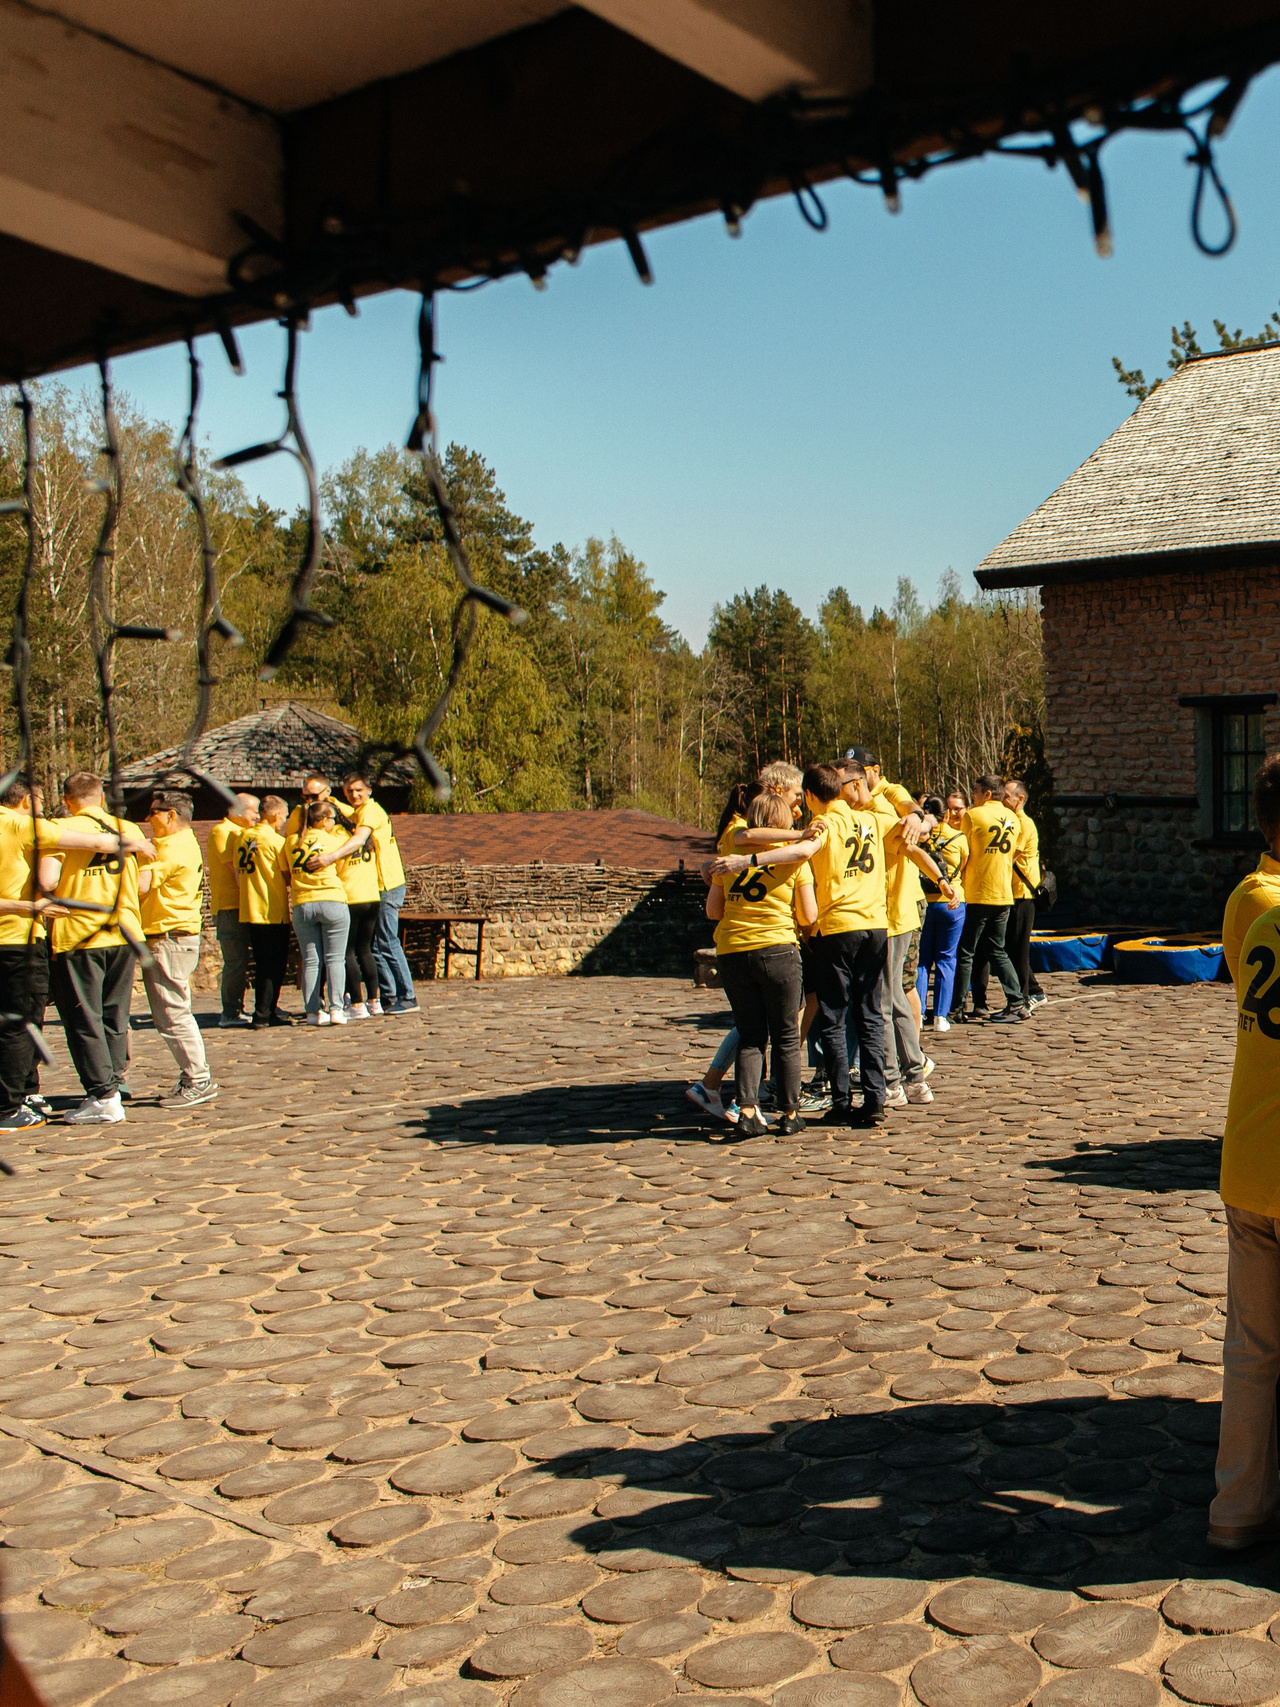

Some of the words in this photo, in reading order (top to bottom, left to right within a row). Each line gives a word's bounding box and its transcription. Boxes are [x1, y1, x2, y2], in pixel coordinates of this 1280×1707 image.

[988, 825, 1011, 854] 26
[238, 847, 255, 874] 26
[348, 859, 361, 867] ЛЕТ
[845, 837, 874, 873] 26
[83, 868, 104, 877] ЛЕТ
[844, 868, 858, 878] ЛЕТ
